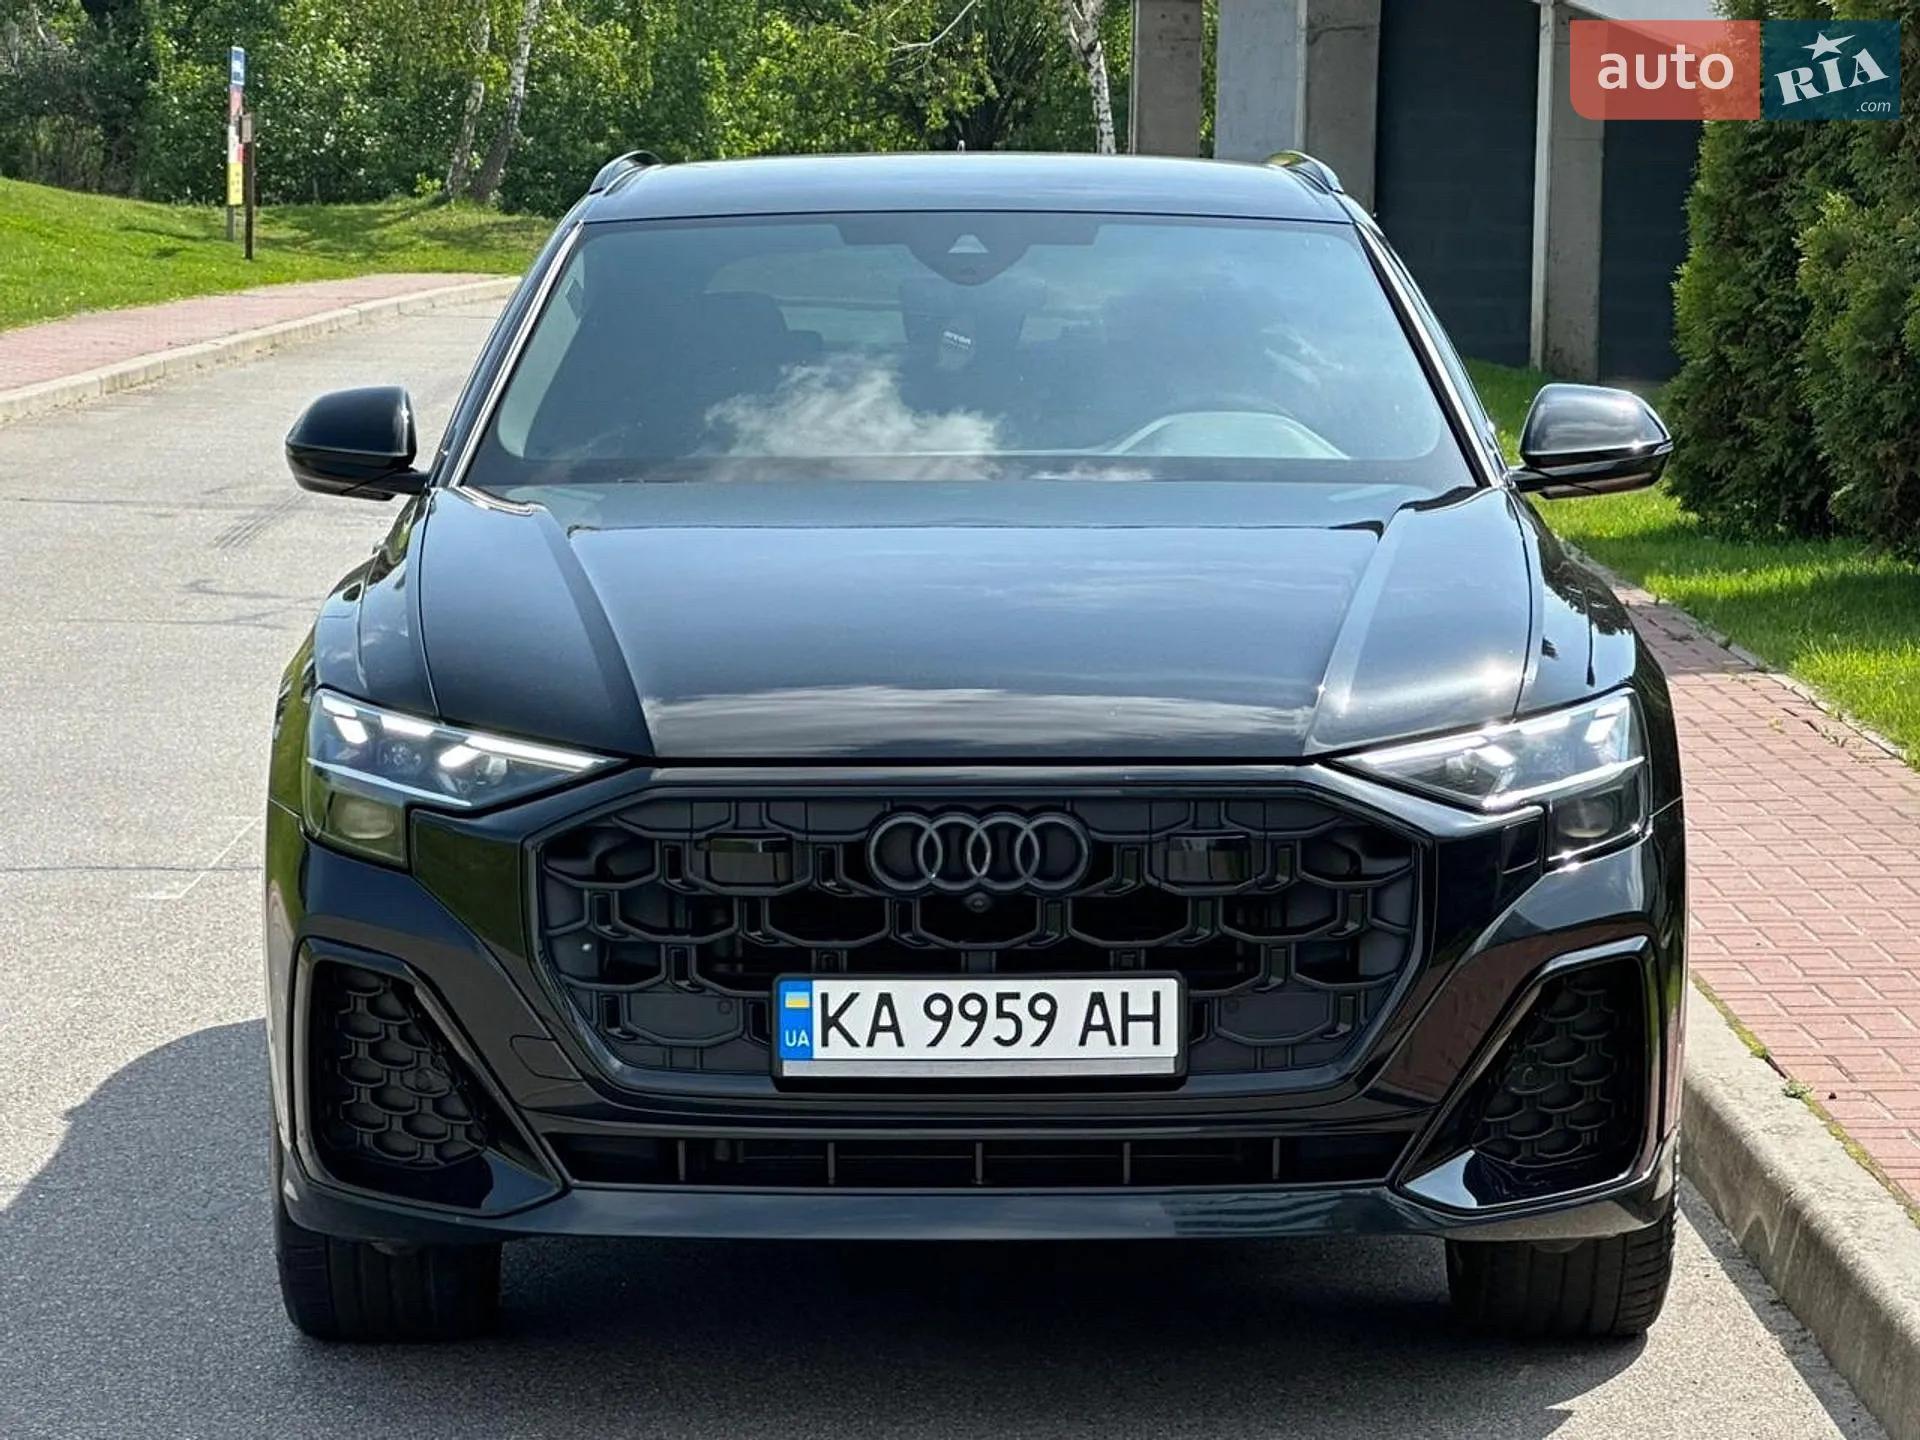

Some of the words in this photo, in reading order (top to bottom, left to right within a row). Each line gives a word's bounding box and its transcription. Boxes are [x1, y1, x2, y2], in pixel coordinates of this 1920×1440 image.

[820, 991, 905, 1048] KA
[923, 991, 1058, 1048] 9959
[1078, 990, 1161, 1047] AH
[785, 1029, 810, 1048] UA
